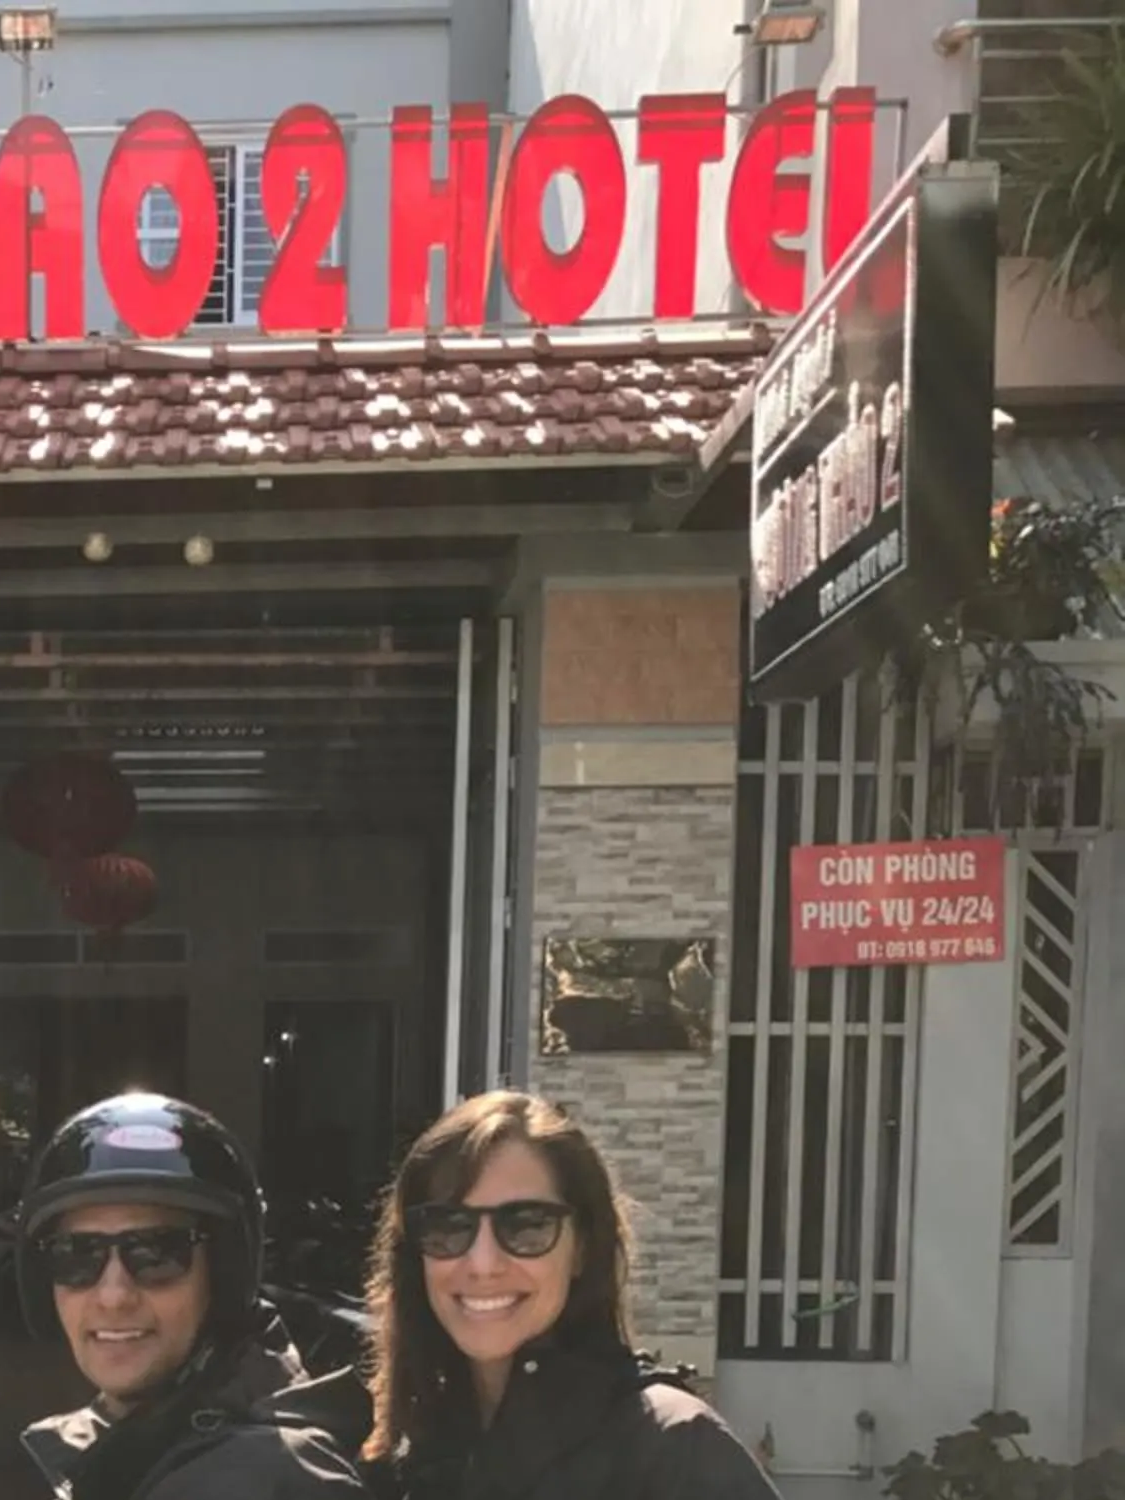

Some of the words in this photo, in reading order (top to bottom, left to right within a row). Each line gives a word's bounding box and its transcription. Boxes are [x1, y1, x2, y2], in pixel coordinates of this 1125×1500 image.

[259, 102, 348, 334] 2
[819, 850, 874, 886] CÒN
[884, 847, 976, 884] PHÒNG
[801, 900, 872, 936] PHỤC
[880, 898, 914, 932] VỤ
[922, 895, 995, 926] 24/24
